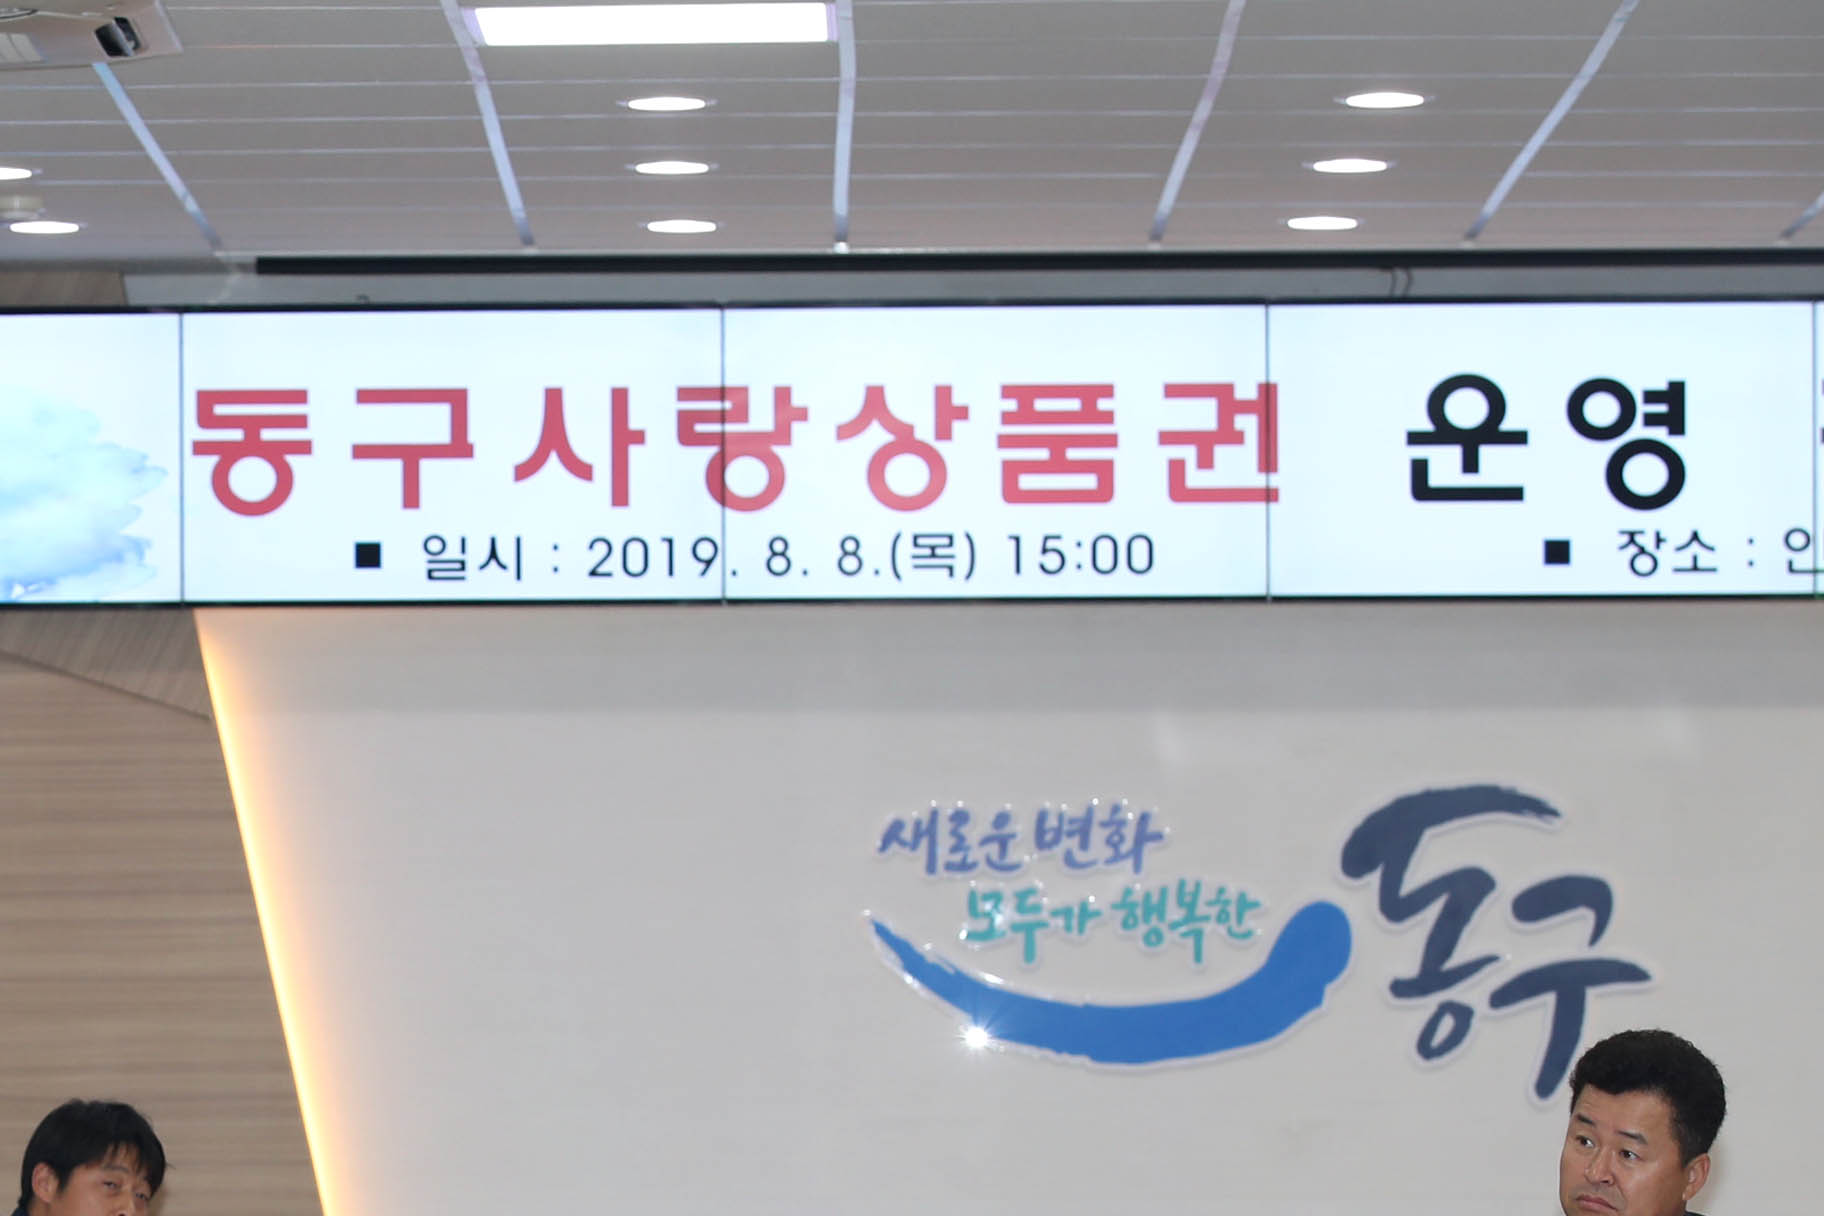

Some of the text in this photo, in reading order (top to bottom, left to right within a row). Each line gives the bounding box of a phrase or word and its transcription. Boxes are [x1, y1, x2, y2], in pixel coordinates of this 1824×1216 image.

[193, 382, 1280, 518] 동구사랑상품권
[1406, 373, 1688, 512] 운영
[424, 535, 522, 580] 일시
[589, 538, 738, 578] 2019.
[1007, 534, 1155, 577] 15:00
[1617, 529, 1719, 577] 장소
[878, 802, 1166, 874] 새로운 변화
[965, 878, 1263, 965] 모두가 행복한
[1340, 783, 1653, 1100] 동구
